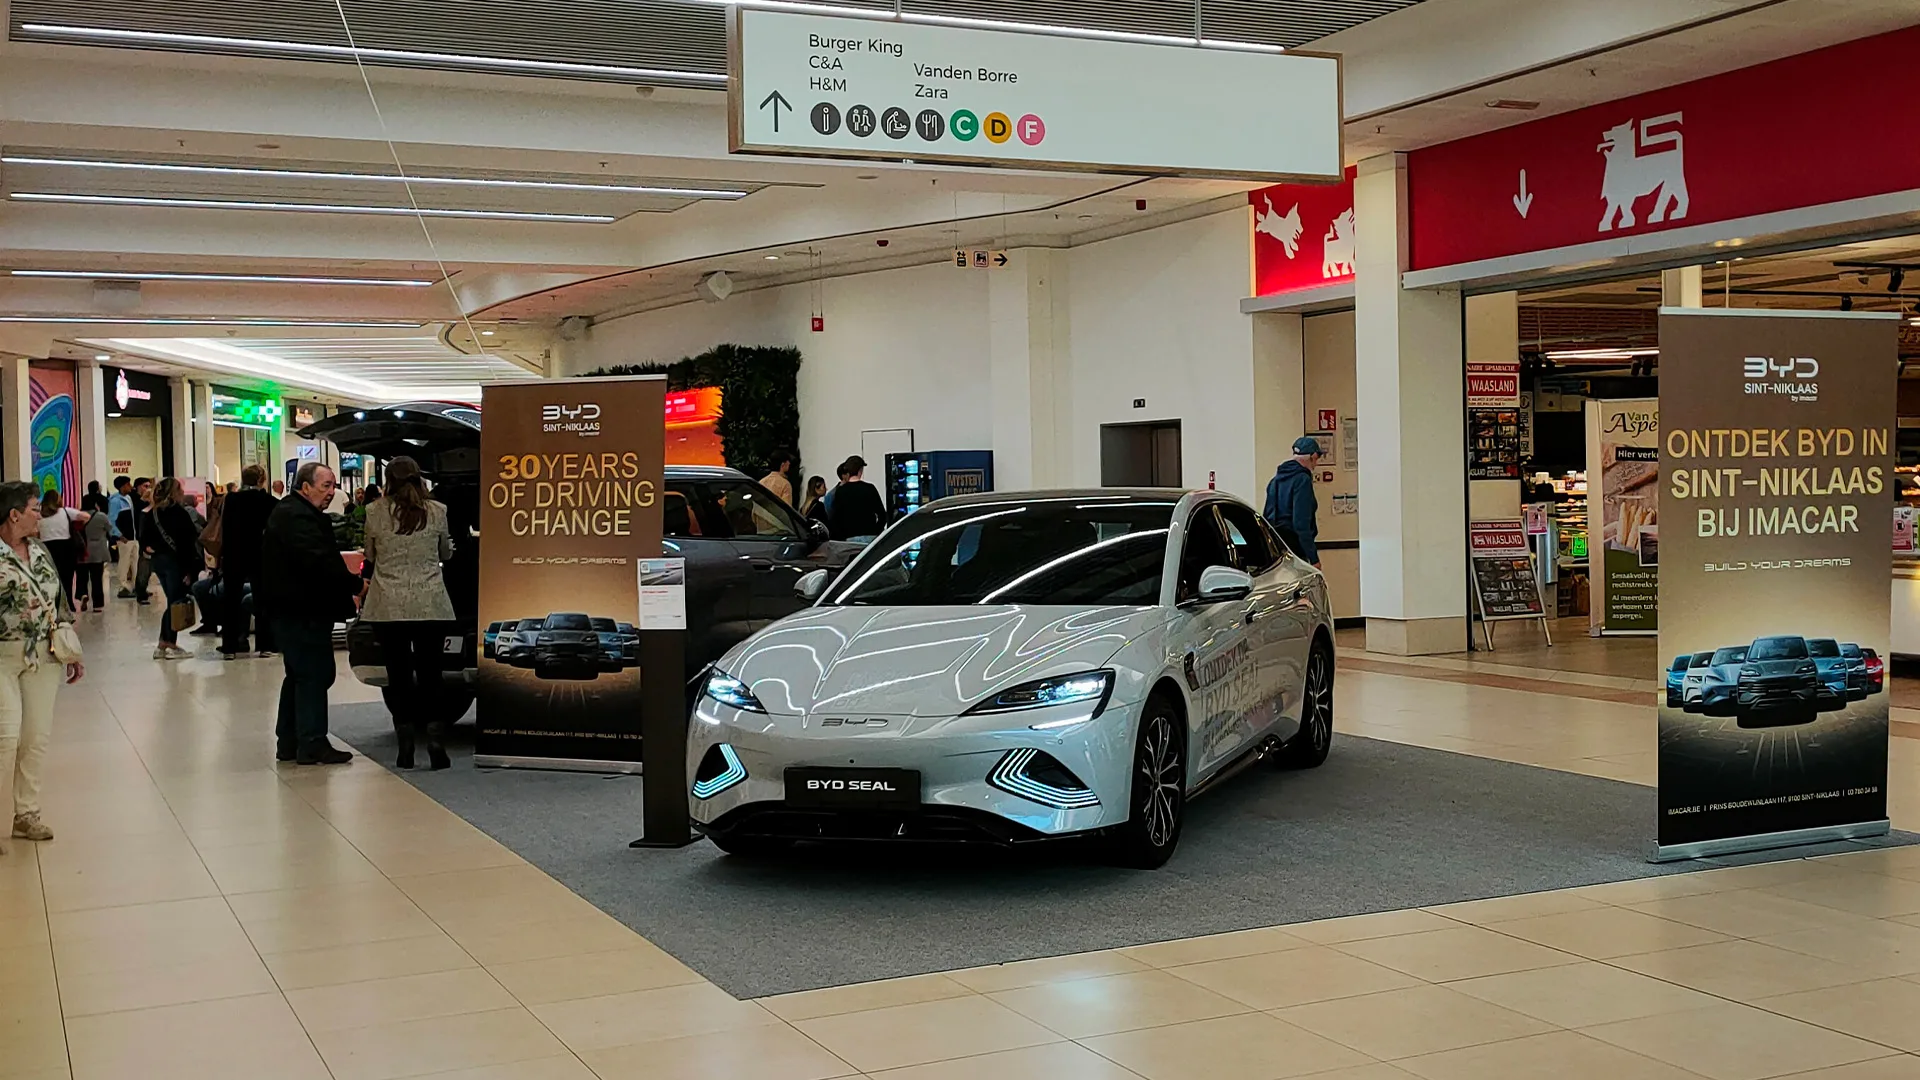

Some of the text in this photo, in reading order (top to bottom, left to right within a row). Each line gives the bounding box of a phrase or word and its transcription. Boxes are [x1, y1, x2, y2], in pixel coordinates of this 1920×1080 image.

[808, 34, 904, 57] Burger King
[808, 56, 843, 71] C&A
[914, 63, 1018, 84] Vanden Borre
[810, 76, 847, 93] H&M
[914, 84, 949, 100] Zara
[955, 116, 1038, 140] C D F
[1744, 357, 1818, 378] BYD
[1471, 380, 1514, 392] WAASLAND
[1744, 383, 1818, 394] SINT-NIKLAAS
[543, 404, 600, 420] BYD
[1628, 412, 1649, 422] Van
[543, 422, 600, 432] SINT-NIKLAAS
[1667, 428, 1888, 458] ONTDEK BYD IN
[1618, 450, 1635, 458] Hier
[948, 474, 982, 486] MYSTERY
[1671, 466, 1883, 498] SINT-NIKLAAS
[489, 480, 654, 508] OF DRIVING
[511, 510, 631, 537] CHANGE
[1698, 506, 1858, 538] BIJ IMACAR
[1485, 534, 1522, 545] WAASLAND
[1704, 558, 1851, 572] BUILD YOUR DREAMS
[1204, 681, 1230, 728] BYD
[1232, 660, 1260, 706] SEAL
[807, 780, 896, 791] BYD SEAL
